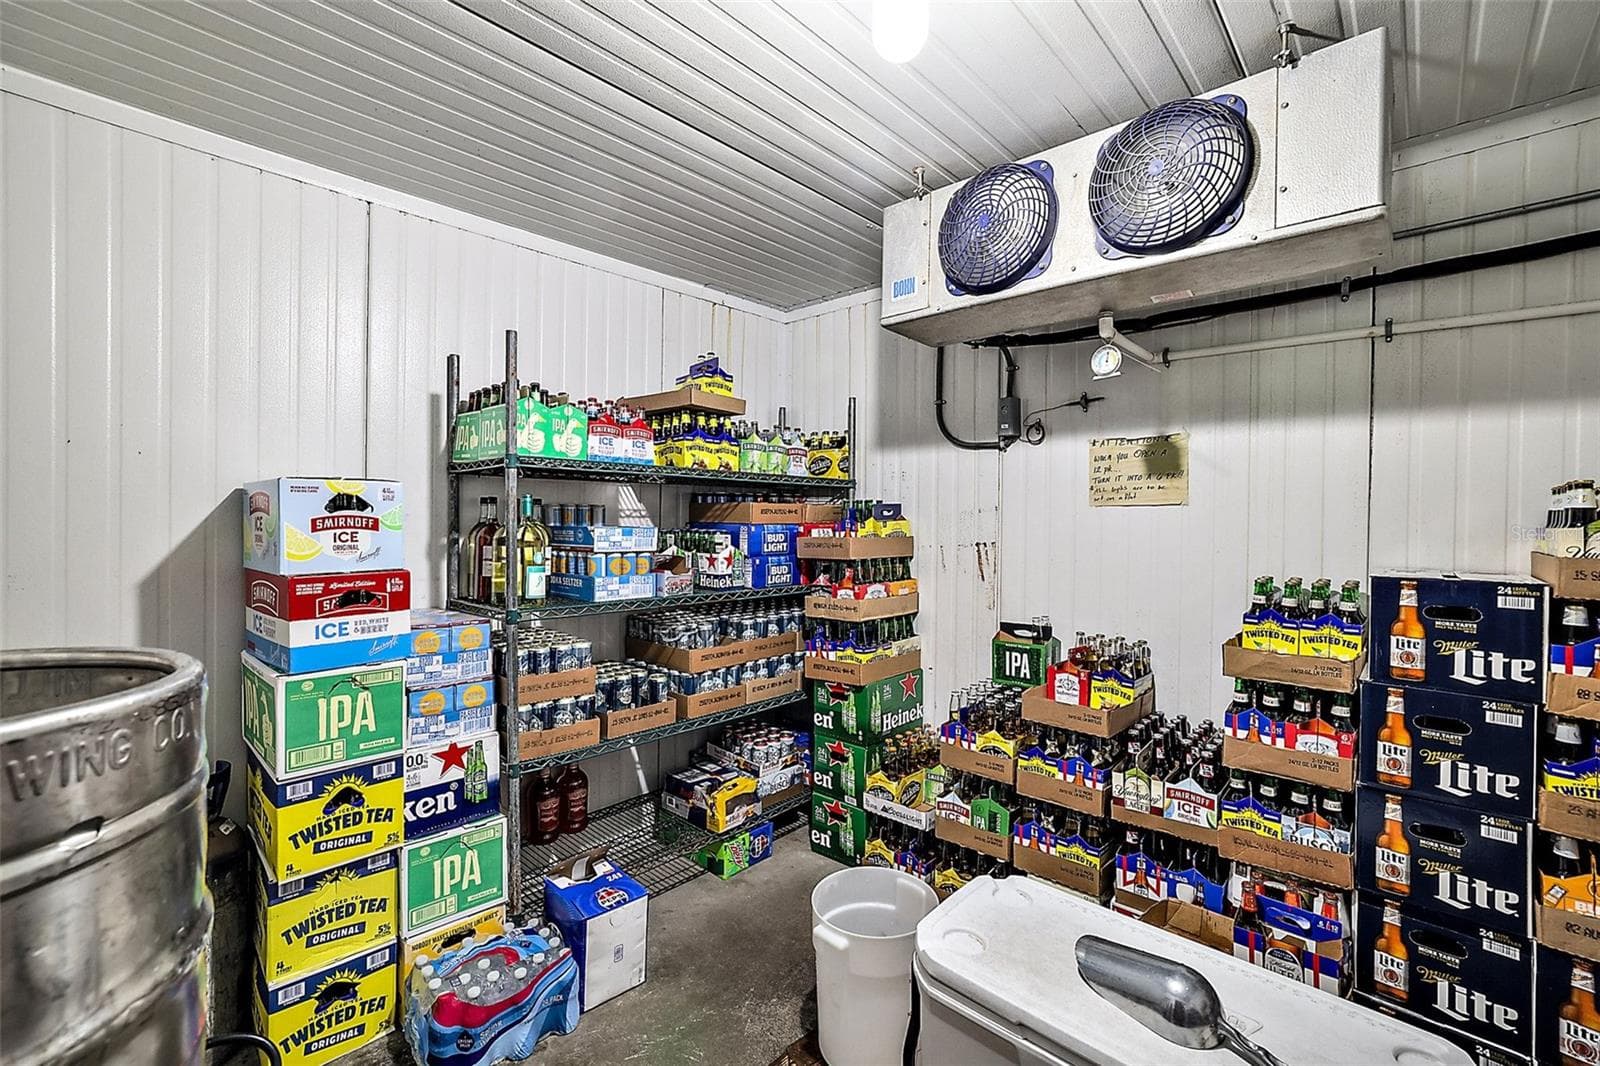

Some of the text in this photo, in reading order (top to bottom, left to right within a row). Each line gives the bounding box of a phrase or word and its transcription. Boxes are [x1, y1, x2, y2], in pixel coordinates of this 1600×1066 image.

[893, 277, 916, 298] BOHN
[552, 417, 565, 433] IPA
[455, 425, 469, 451] IPA
[482, 419, 496, 449] IPA
[599, 438, 614, 447] ICE
[631, 441, 646, 450] ICE
[1161, 449, 1168, 457] A
[1126, 473, 1143, 482] INTO
[316, 517, 375, 530] SMIRNOFF
[333, 531, 359, 543] ICE
[767, 533, 783, 543] BUD
[332, 544, 360, 552] ORIGINAL
[764, 542, 787, 552] LIGHT
[771, 565, 787, 574] BUD
[700, 574, 733, 588] Heinek
[767, 573, 791, 584] LIGHT
[1497, 586, 1513, 595] 24
[314, 621, 350, 640] ICE
[1244, 631, 1296, 644] TWISTED TEA
[1302, 636, 1358, 651] TWISTED TEA
[1396, 636, 1420, 650] Lite
[1433, 639, 1479, 656] Miller
[1005, 651, 1031, 680] IPA
[1450, 649, 1536, 685] Lite
[1092, 685, 1132, 702] TWISTED TEA
[245, 680, 260, 735] IPA
[1483, 700, 1496, 710] 24
[318, 689, 376, 742] IPA
[882, 702, 924, 731] Heinek
[1441, 732, 1463, 740] TASTE
[5, 707, 191, 802] WING CO.
[1382, 744, 1407, 757] Lite
[1419, 749, 1464, 764] Miller
[1021, 765, 1056, 779] TWISTED TEA
[1318, 764, 1339, 773] BOTTLES
[1435, 758, 1520, 800] Lite
[1169, 788, 1210, 806] SMIRNOFF
[1552, 785, 1600, 799] TWIST
[1178, 801, 1202, 816] ICE
[945, 812, 961, 822] ICE
[973, 815, 986, 829] IPA
[1178, 813, 1202, 824] ORIGINAL
[1480, 815, 1495, 824] 24
[287, 813, 364, 850] TWISTED
[366, 807, 395, 827] TEA
[1225, 818, 1278, 838] TWISTED TEA
[319, 834, 367, 851] ORIGINAL
[1420, 839, 1461, 852] MORE TASTE
[1058, 851, 1099, 871] TWISTED TEA
[1381, 850, 1405, 864] Lite
[433, 848, 481, 899] IPA
[1418, 858, 1462, 875] Miller
[600, 892, 627, 906] PEPSI
[1433, 870, 1520, 917] Lite
[281, 897, 388, 946] TWISTED TEA
[378, 924, 391, 934] 5%
[312, 925, 360, 945] ORIGINAL
[1479, 928, 1494, 938] 24
[411, 939, 432, 952] NOBODY
[432, 933, 449, 944] MAKES
[1379, 954, 1404, 968] Lite
[1418, 946, 1460, 962] MORE TASTE
[1416, 965, 1461, 983] Miller
[1432, 977, 1519, 1034] Lite
[279, 997, 387, 1055] TWISTED TEA
[1565, 1021, 1600, 1043] Lite
[311, 1028, 359, 1052] ORIGINAL
[1476, 1045, 1491, 1056] 24
